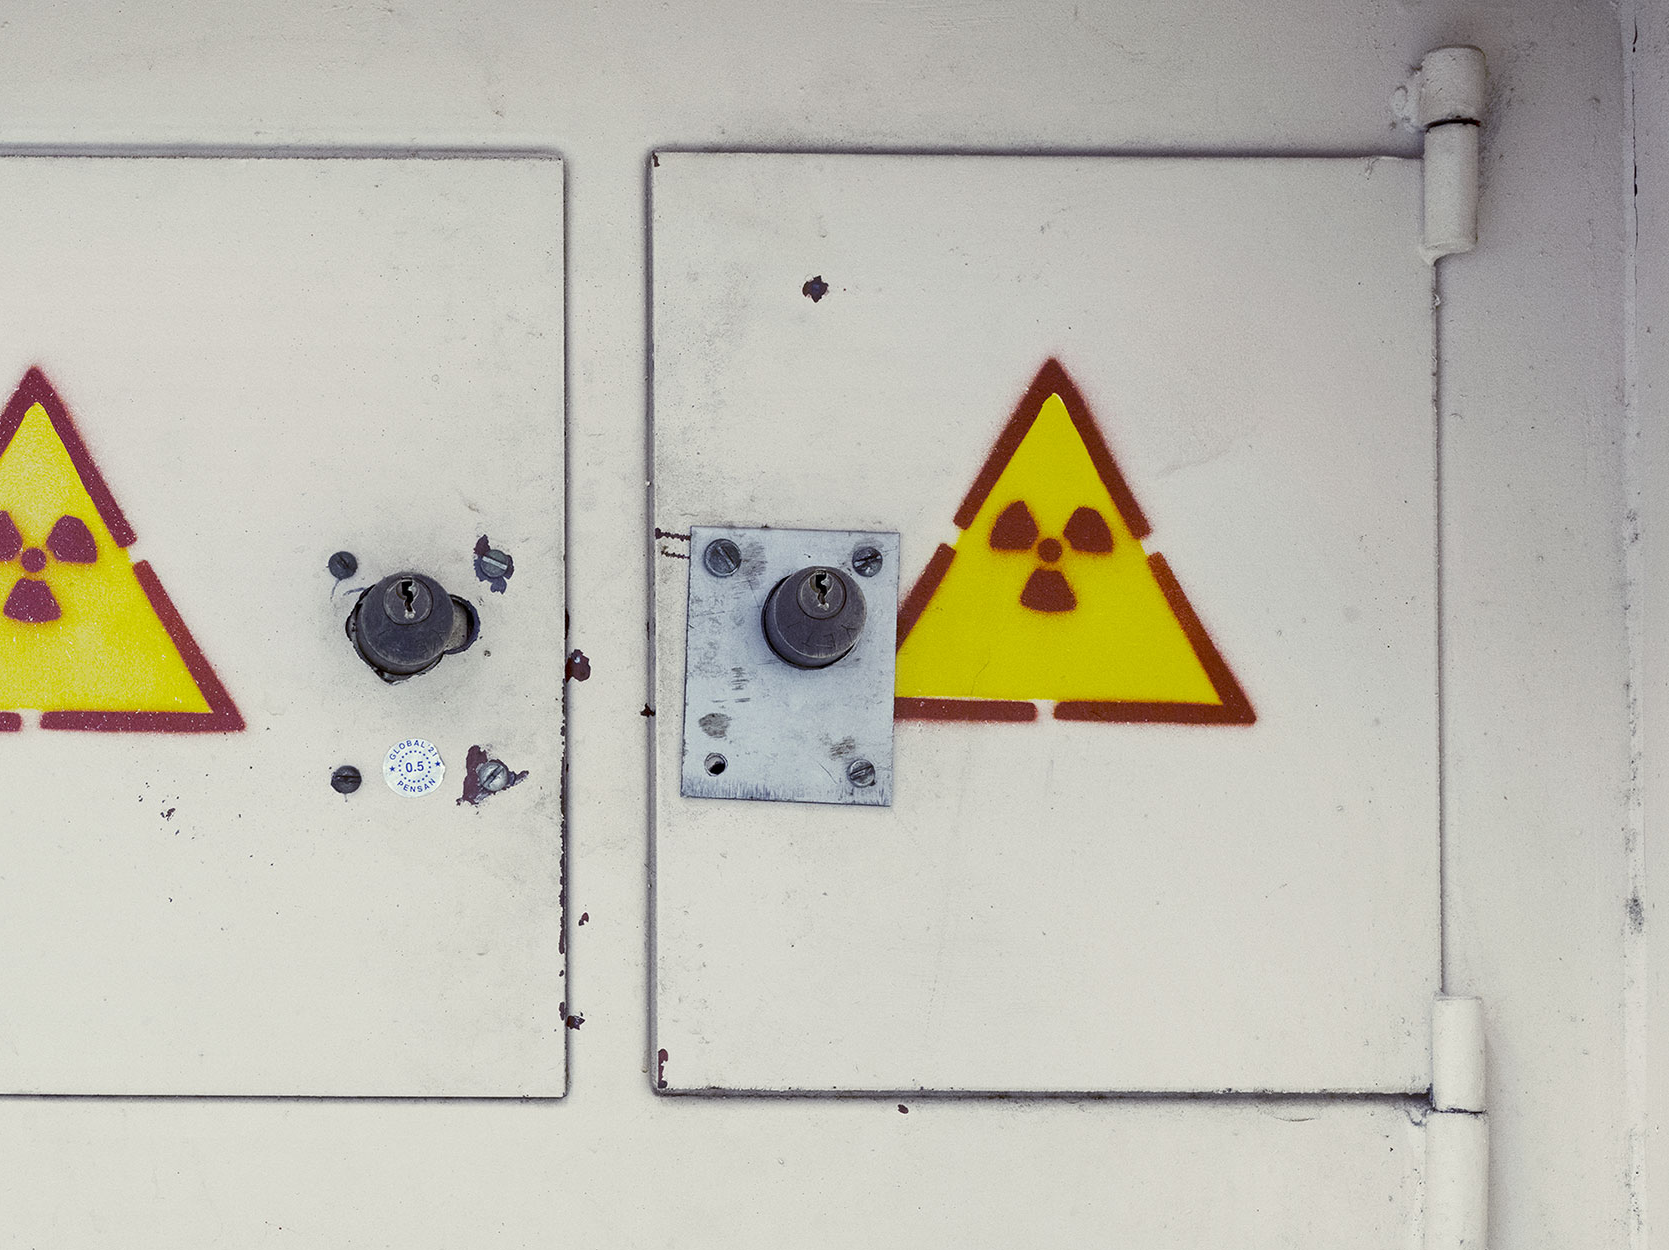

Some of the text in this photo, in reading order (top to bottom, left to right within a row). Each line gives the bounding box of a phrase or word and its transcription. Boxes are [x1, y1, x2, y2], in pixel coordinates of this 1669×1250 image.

[389, 740, 425, 760] GLOBAL
[405, 760, 424, 773] 0.5
[397, 778, 436, 793] PENSAN
